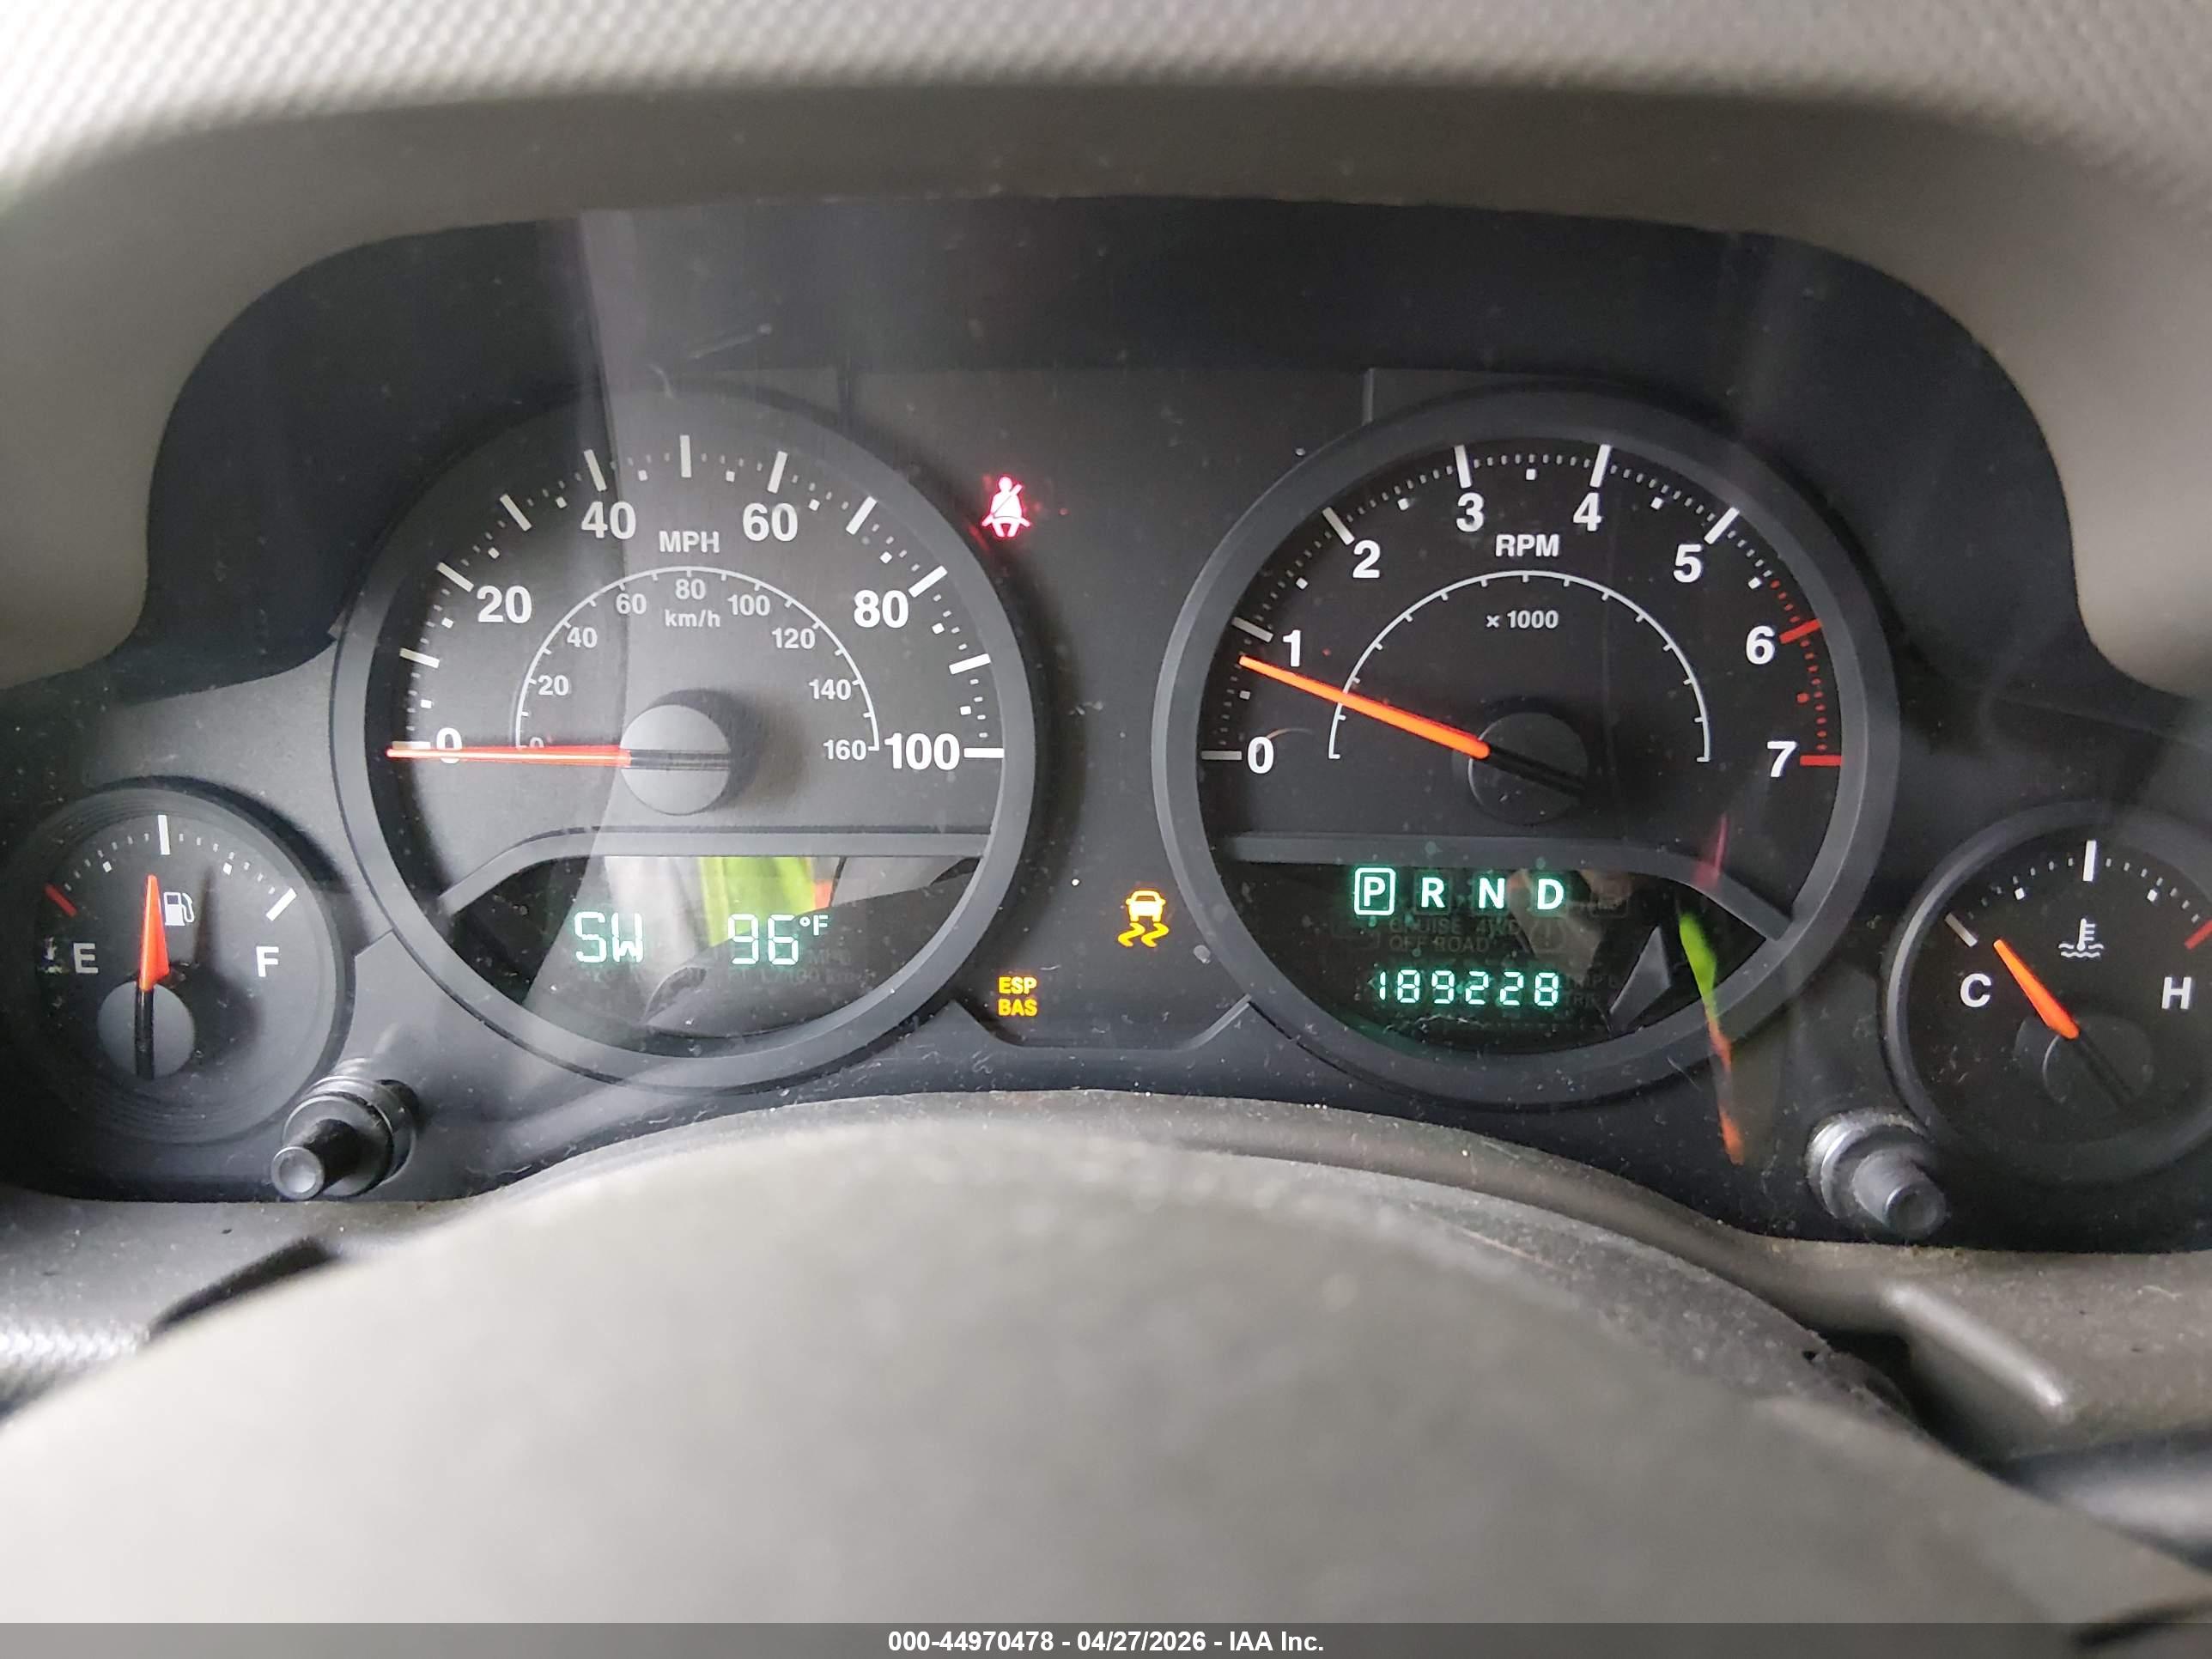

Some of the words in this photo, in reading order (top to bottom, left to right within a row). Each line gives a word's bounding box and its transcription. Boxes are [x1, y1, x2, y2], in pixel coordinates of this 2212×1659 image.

[580, 501, 638, 540] 40
[741, 501, 799, 542] 60
[1455, 492, 1484, 532] 3
[1572, 492, 1603, 532] 4
[658, 529, 720, 554] MPH
[1352, 538, 1382, 579] 2
[1495, 533, 1560, 558] RPM
[1673, 544, 1704, 583] 5
[476, 584, 533, 625] 20
[615, 592, 647, 616] 60
[674, 577, 708, 601] 80
[726, 592, 771, 617] 100
[664, 608, 721, 629] km/h
[853, 588, 910, 629] 80
[1506, 610, 1560, 629] 1000
[566, 626, 599, 649] 40
[770, 626, 817, 650] 120
[1282, 629, 1303, 667] 1
[1745, 625, 1777, 665] 6
[537, 673, 570, 697] 20
[807, 678, 852, 702] 140
[436, 727, 463, 764] 0
[823, 738, 866, 762] 160
[883, 732, 961, 771] 100
[1247, 736, 1275, 774] 0
[1765, 740, 1797, 778] 7
[1362, 876, 1387, 908] P
[1421, 876, 1445, 909] R
[1478, 878, 1505, 908] N
[1536, 878, 1565, 910] D
[574, 911, 644, 963] SW
[73, 942, 99, 975] E
[256, 945, 280, 977] F
[998, 976, 1037, 994] ESP
[1379, 969, 1559, 1007] 189228
[1960, 973, 1992, 1008] C
[2161, 976, 2192, 1010] H
[998, 999, 1037, 1017] BAS
